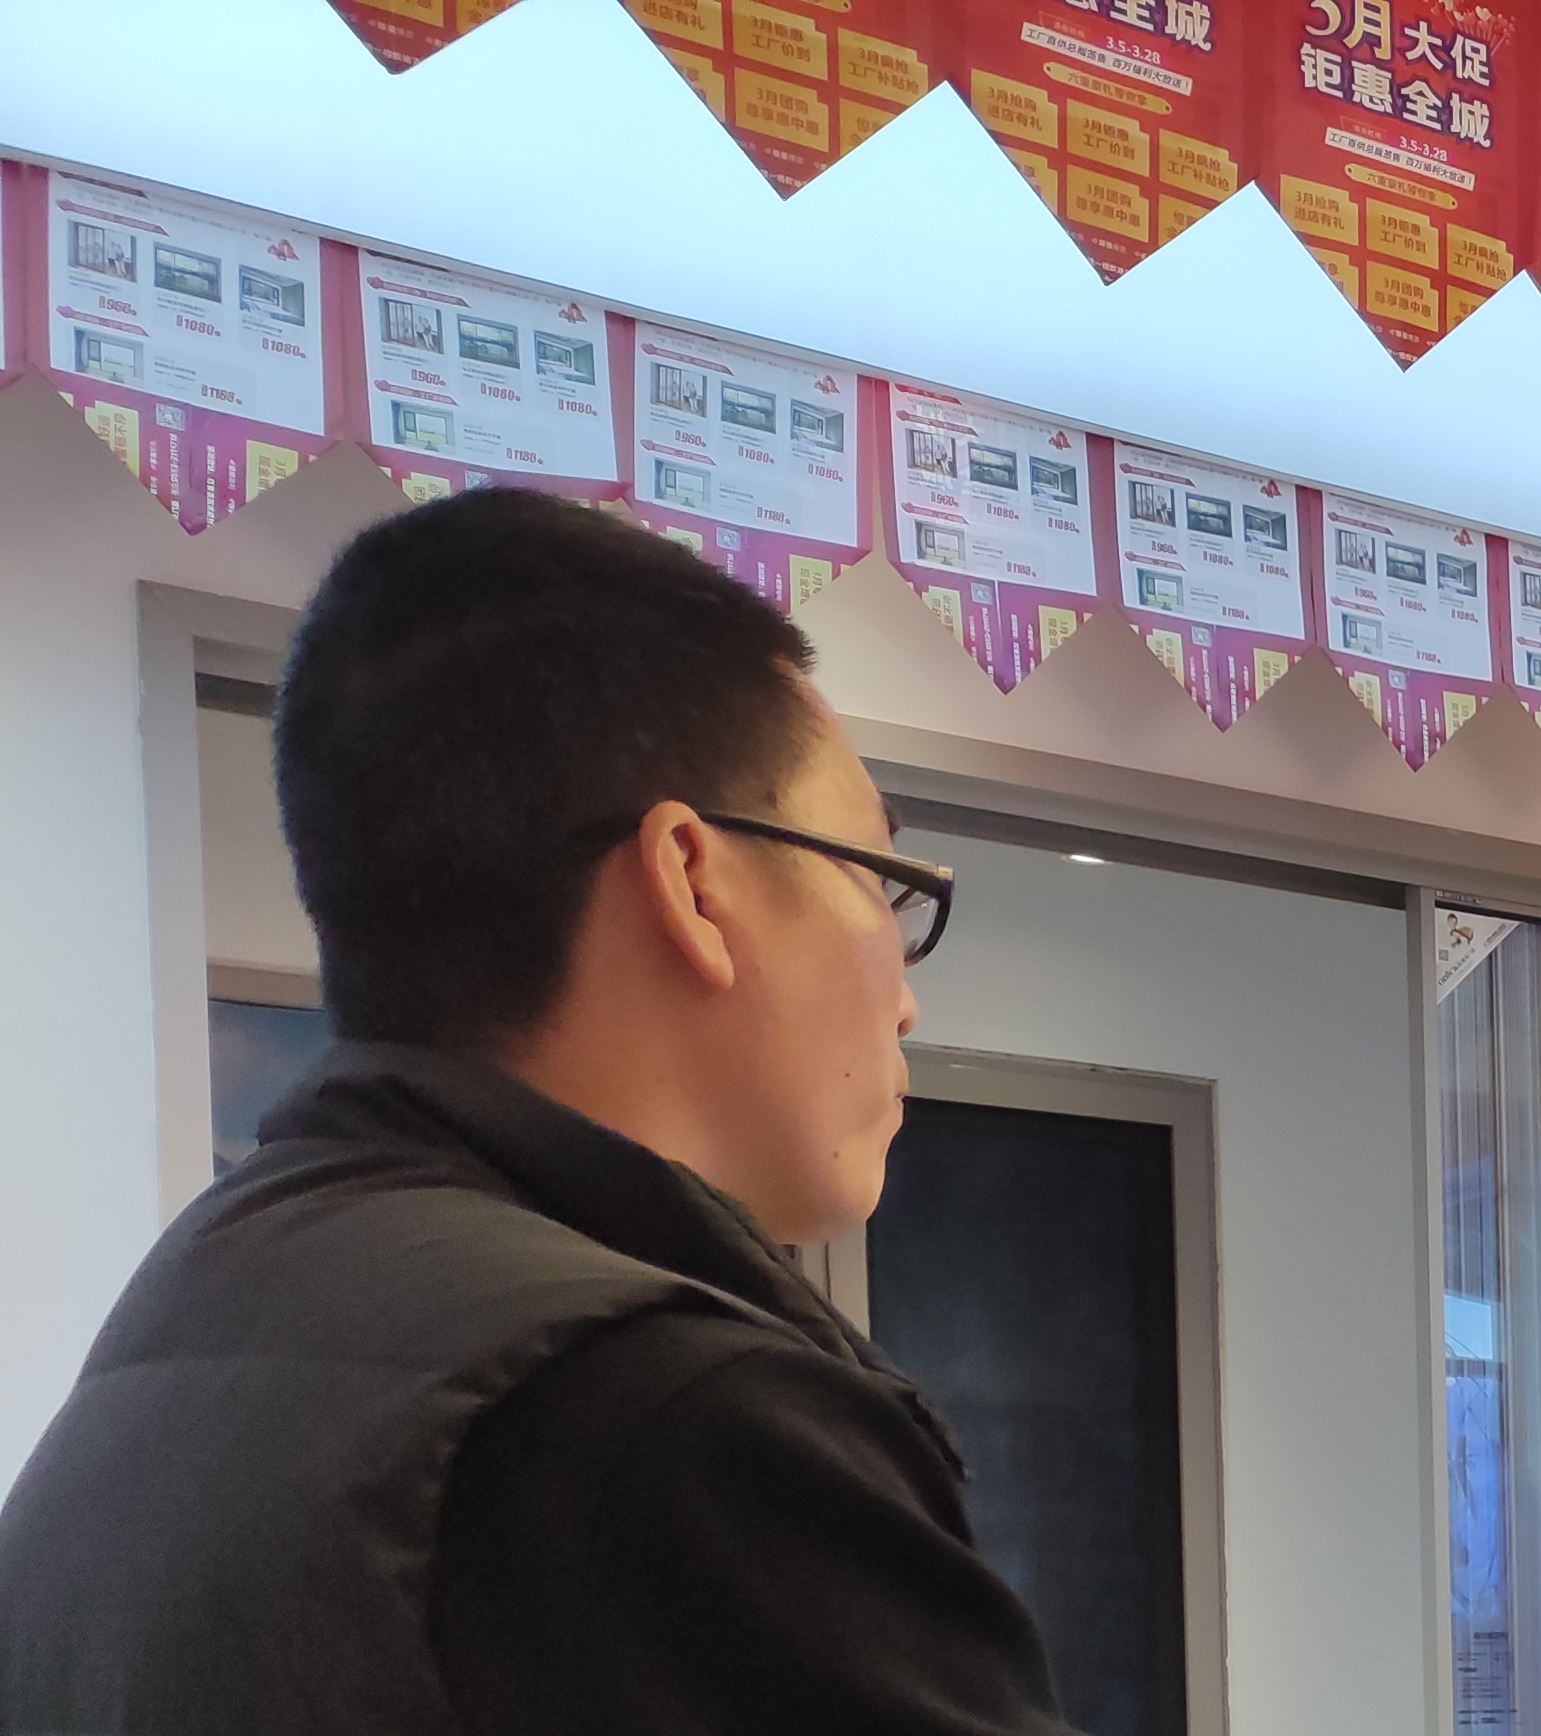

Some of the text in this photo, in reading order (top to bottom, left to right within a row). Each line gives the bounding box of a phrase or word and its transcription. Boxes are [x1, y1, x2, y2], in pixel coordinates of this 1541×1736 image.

[1105, 36, 1161, 65] 3.5-3.28
[1300, 41, 1492, 146] 钜惠全城
[1399, 137, 1447, 161] 3.5-3.28
